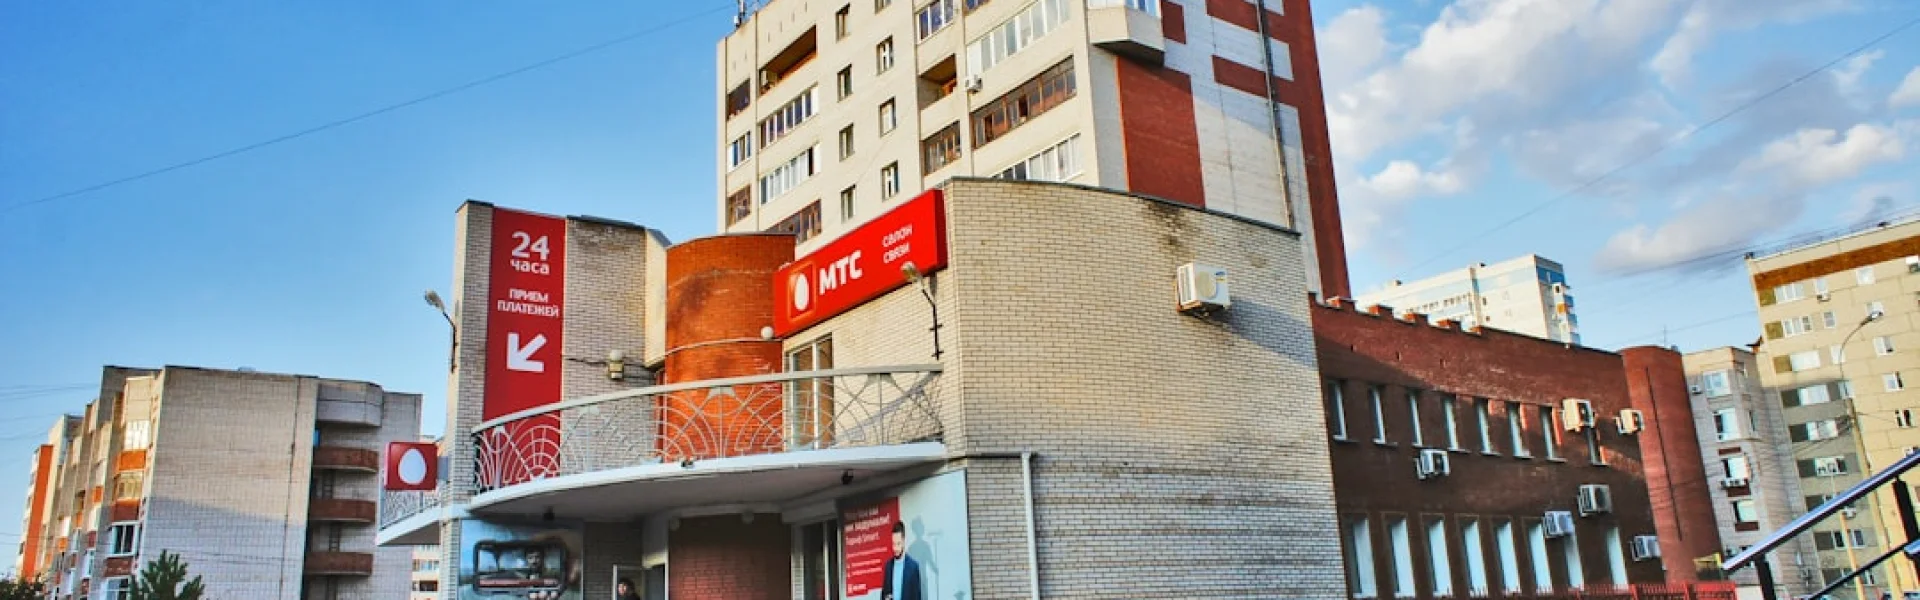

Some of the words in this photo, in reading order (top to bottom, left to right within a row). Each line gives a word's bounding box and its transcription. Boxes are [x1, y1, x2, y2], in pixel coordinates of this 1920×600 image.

[511, 231, 550, 260] 24
[510, 259, 550, 275] часа
[819, 250, 862, 295] МТС
[509, 288, 548, 303] ПРИЕМ
[497, 299, 559, 318] ПЛАТЕЖЕЙ
